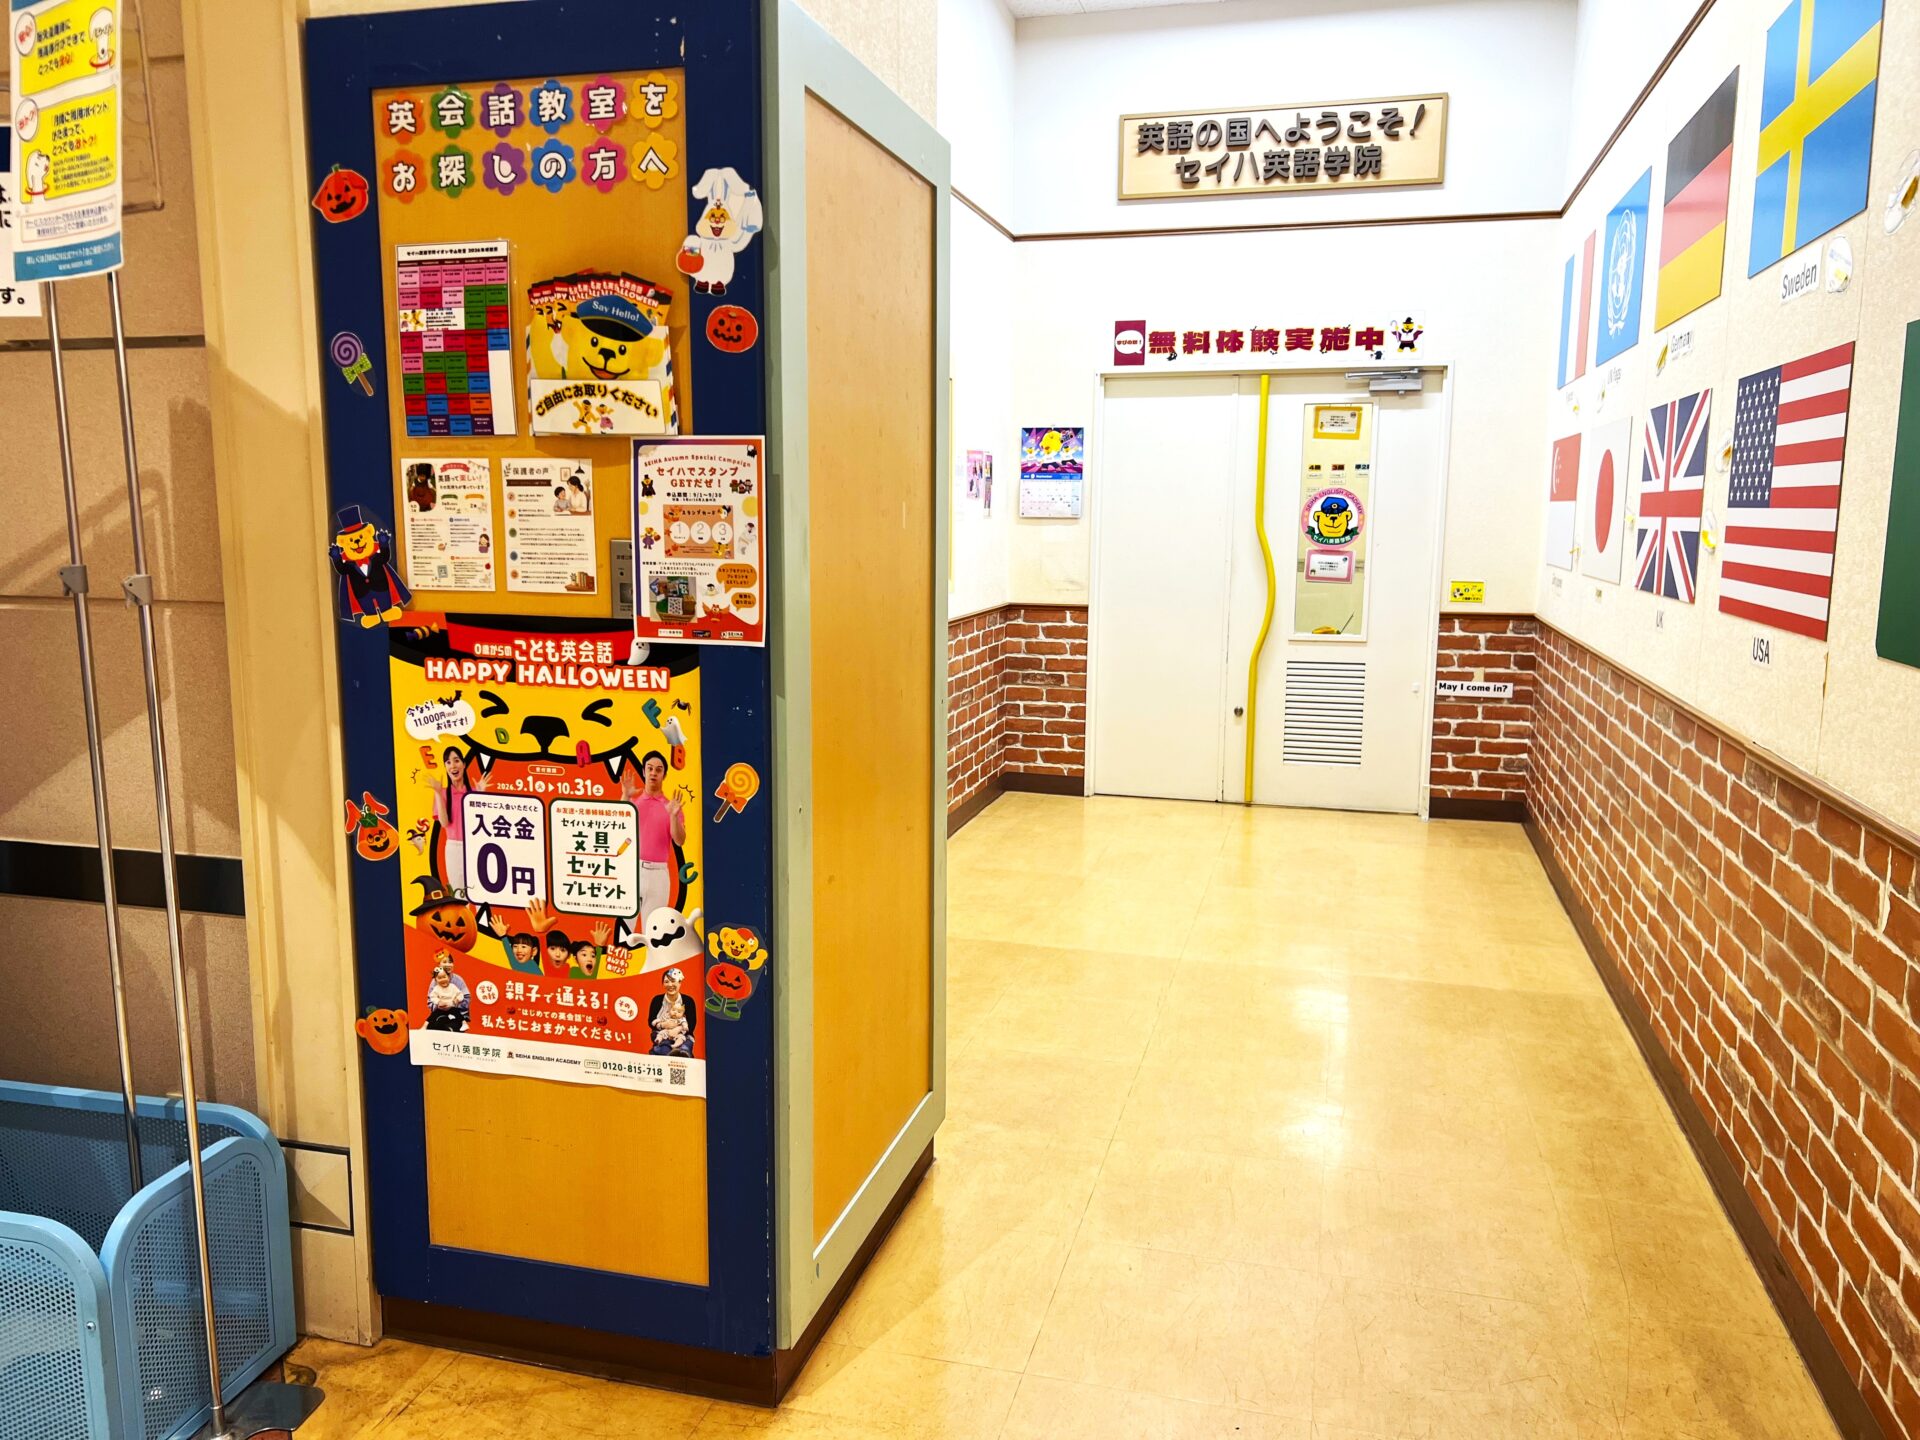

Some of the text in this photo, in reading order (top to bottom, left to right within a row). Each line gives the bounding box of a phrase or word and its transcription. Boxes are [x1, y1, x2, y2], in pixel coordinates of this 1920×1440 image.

[387, 83, 668, 134] 英会話教室を
[1138, 103, 1426, 154] 英語の国へようこそ！
[391, 147, 669, 193] お探しの方へ
[1176, 144, 1382, 184] セイハ英語学院
[1782, 263, 1817, 299] Sweden
[611, 305, 640, 322] Hello!
[1148, 327, 1385, 355] 無料体験実施中
[535, 384, 658, 418] ご自由にお取りください
[512, 467, 549, 475] 保護者の声
[656, 467, 739, 476] セイハでスタンプ
[691, 454, 716, 462] Special
[718, 456, 751, 468] Campaign
[1753, 636, 1770, 664] USA
[426, 660, 668, 690] HAPPY HALLOWEEN
[1438, 682, 1458, 692] May
[1466, 684, 1490, 692] come
[469, 801, 538, 812] 期間中にご入会いただくと
[471, 814, 535, 840] 入会金
[561, 818, 627, 830] セイハオリジナル
[572, 831, 610, 853] 文具
[477, 842, 536, 896] 0円
[567, 856, 616, 877] セット
[562, 882, 626, 900] プレゼント
[505, 980, 609, 1009] 親子で通える!
[481, 1014, 632, 1043] 私たちにおまかせください!
[432, 1042, 502, 1058] セイハ英語学院
[556, 1057, 581, 1065] ACADEMY
[602, 1061, 663, 1076] 0120-815-718
